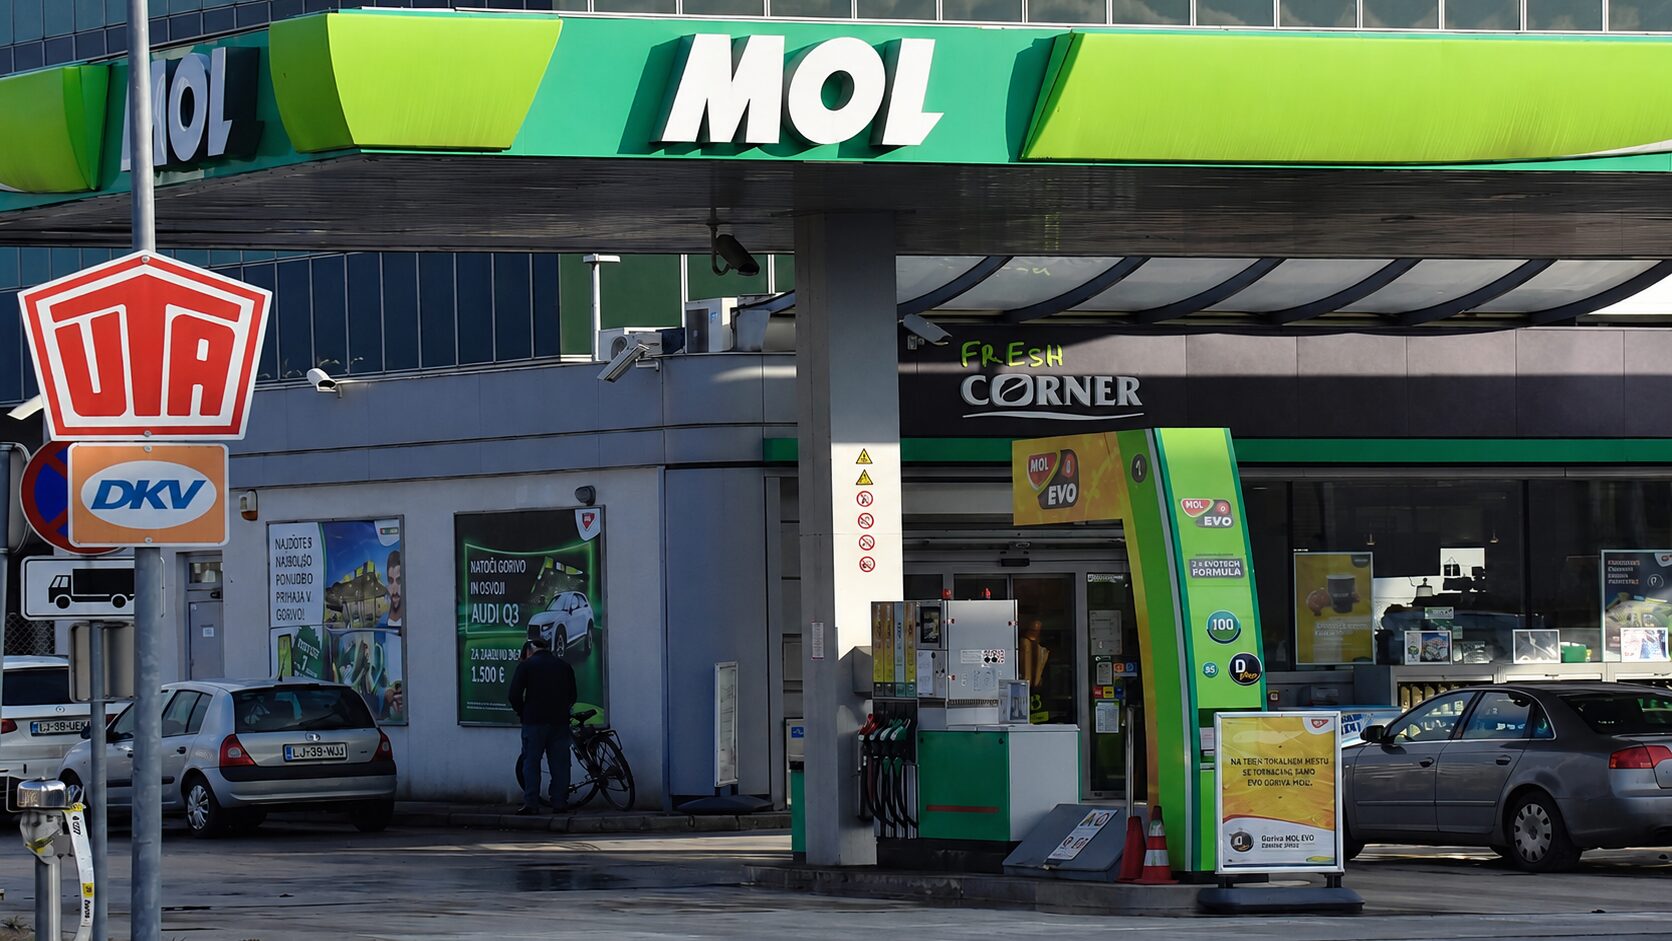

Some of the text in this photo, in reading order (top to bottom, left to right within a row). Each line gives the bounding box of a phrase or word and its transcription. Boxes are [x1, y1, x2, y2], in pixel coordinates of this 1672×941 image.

[661, 33, 945, 146] MOL
[49, 274, 242, 417] UTA
[960, 340, 1064, 368] FRESH
[959, 372, 1144, 408] CORNER
[1030, 457, 1049, 473] MOL
[90, 479, 208, 510] DKV
[1047, 482, 1078, 506] EVO
[1185, 500, 1204, 509] MOL
[1204, 516, 1233, 527] EVO
[470, 557, 527, 574] NATOČI GORIVO
[1192, 568, 1242, 577] FORMULA
[470, 581, 506, 595] IN OSVOJI
[471, 603, 520, 627] AUDI Q3
[1212, 618, 1235, 631] 100
[1235, 659, 1247, 673] D
[471, 666, 506, 684] 1.500 €
[1301, 833, 1315, 842] EVO
